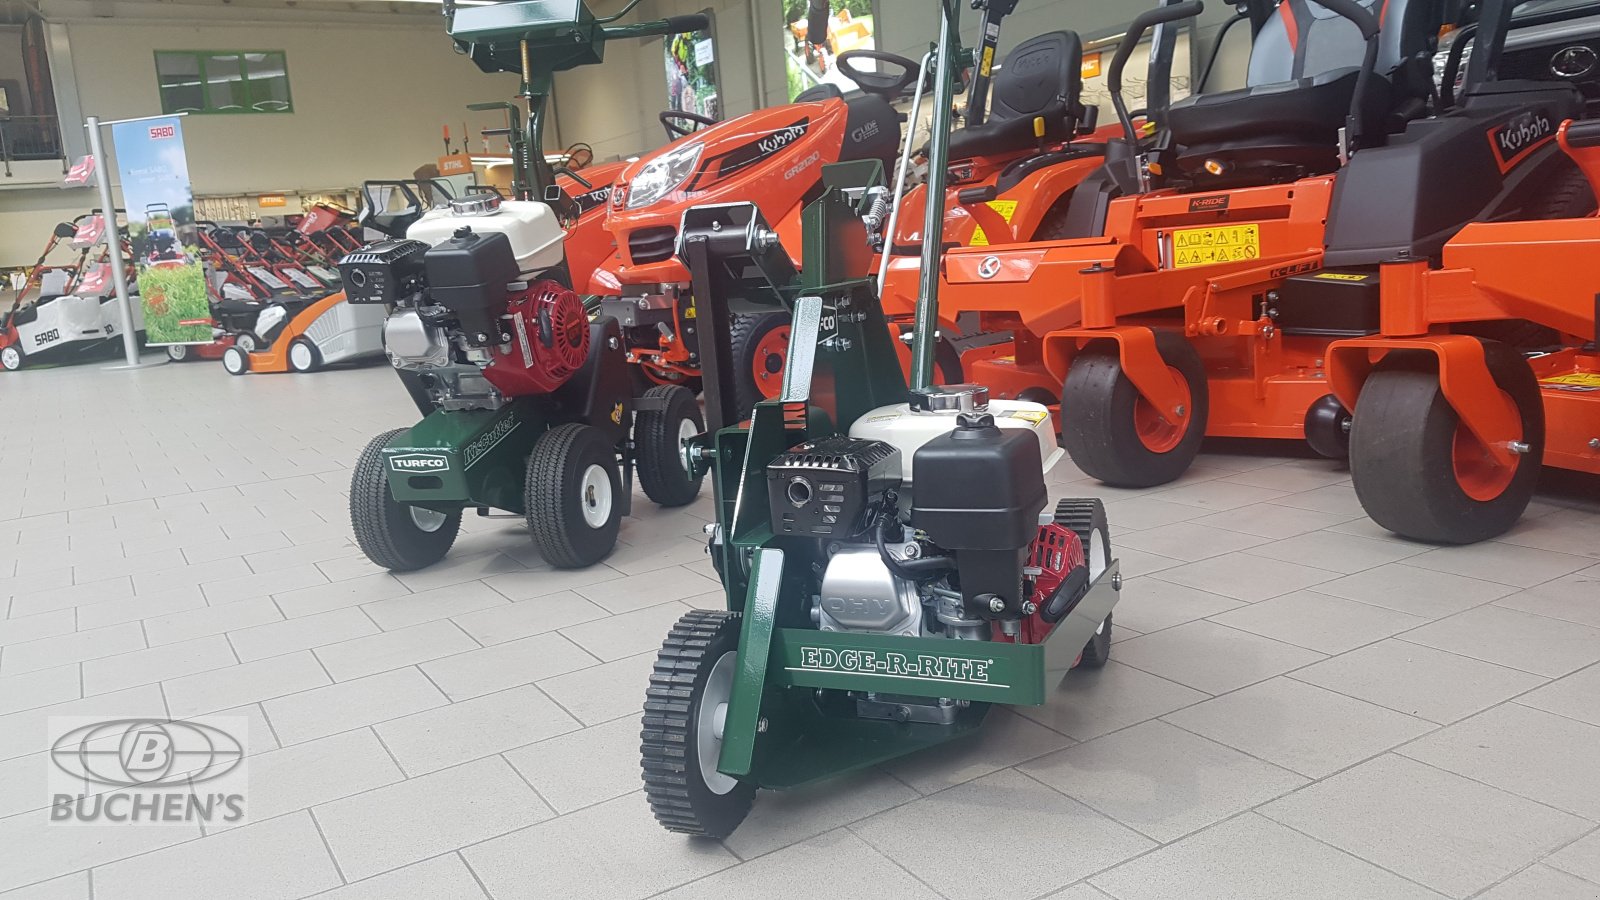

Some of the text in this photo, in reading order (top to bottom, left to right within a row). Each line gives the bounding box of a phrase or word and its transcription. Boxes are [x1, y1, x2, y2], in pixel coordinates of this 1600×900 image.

[150, 126, 174, 139] SABO
[758, 126, 805, 152] Kubota
[1500, 115, 1549, 150] Kubota
[443, 160, 463, 170] STIHL
[1192, 197, 1226, 206] K-RIDE
[1271, 261, 1318, 278] K-LIFT
[35, 328, 60, 346] SABO
[394, 458, 444, 467] TURFCO
